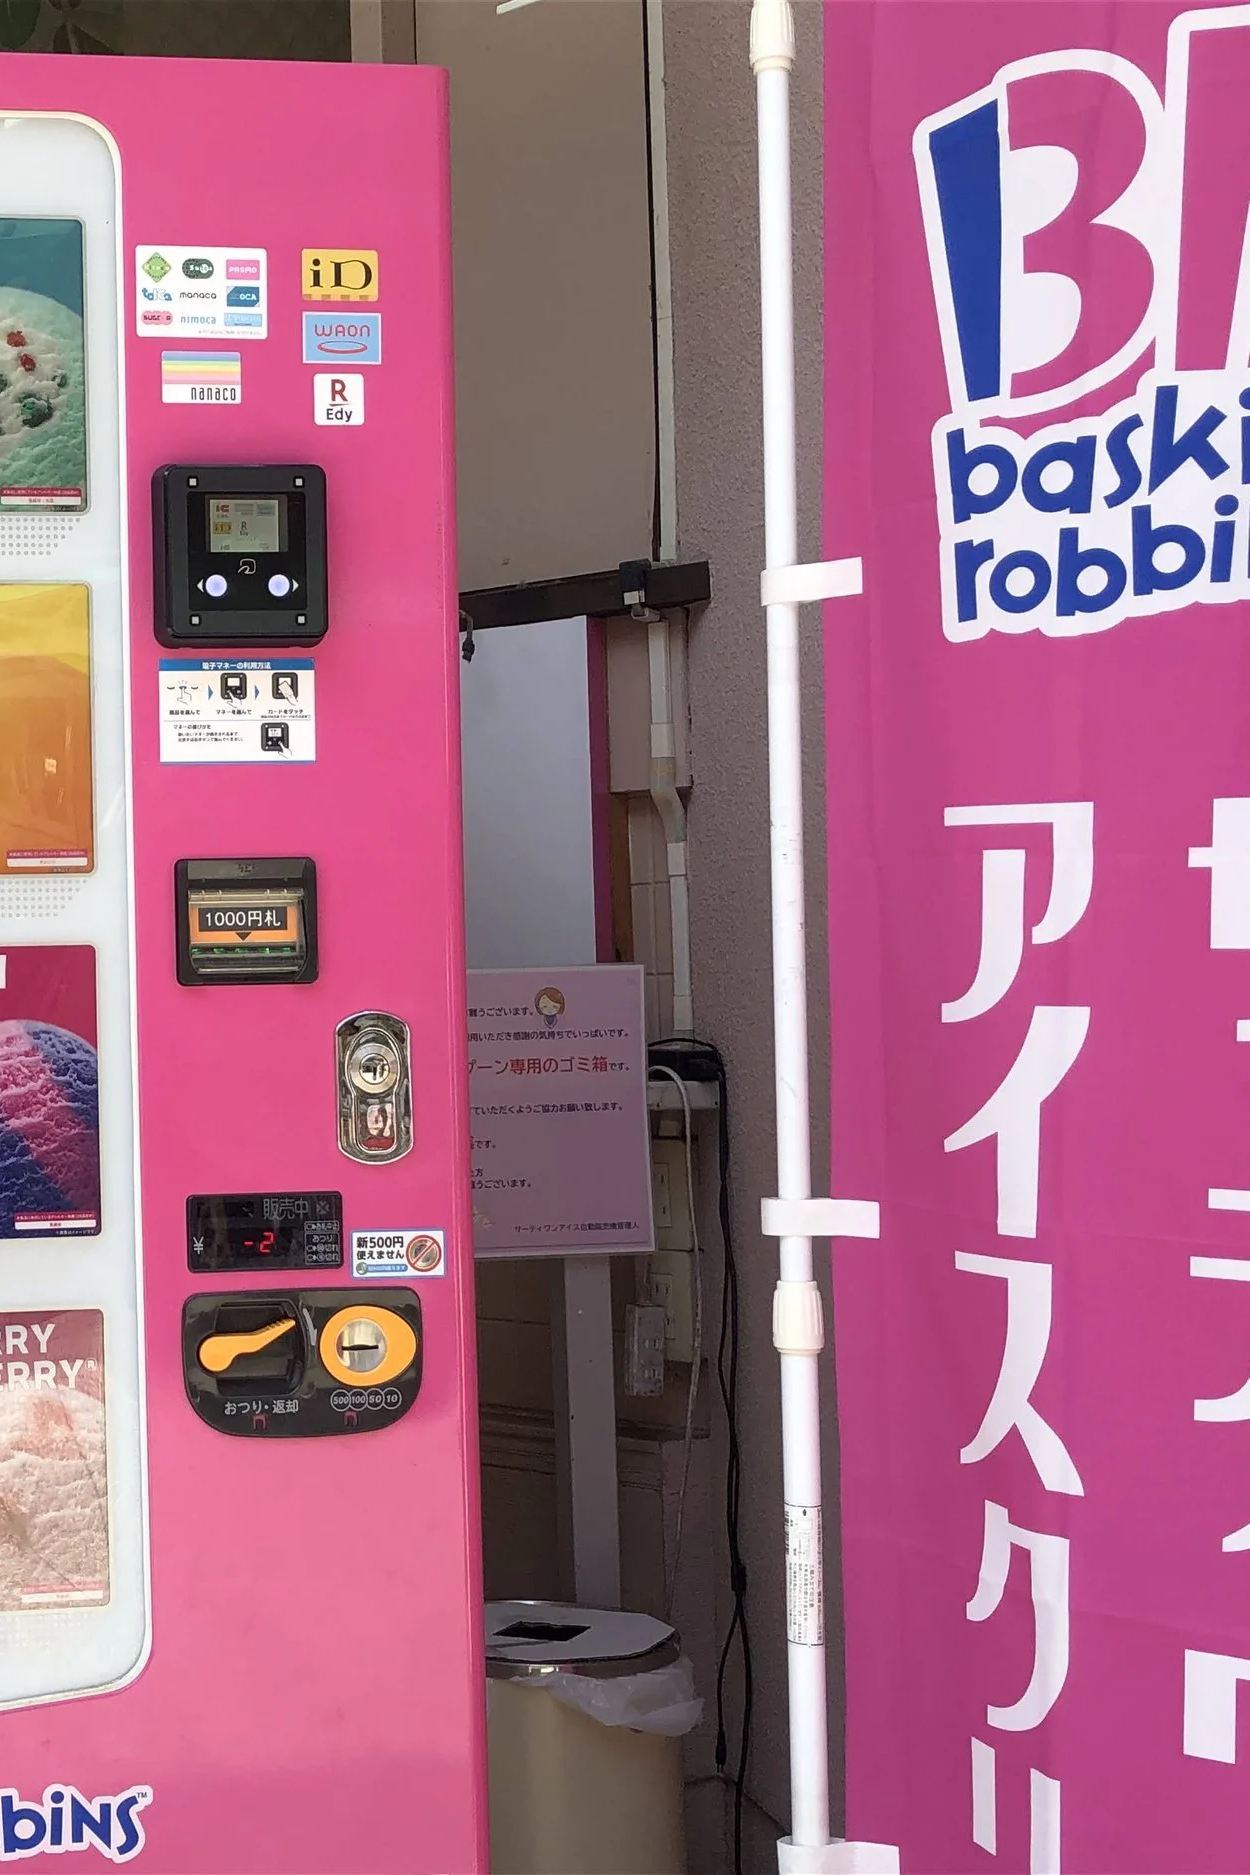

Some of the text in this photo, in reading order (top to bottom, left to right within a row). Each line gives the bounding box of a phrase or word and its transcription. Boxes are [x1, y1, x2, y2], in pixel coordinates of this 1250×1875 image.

[309, 258, 373, 291] iD
[181, 315, 217, 325] nimoca
[315, 323, 371, 338] WAON
[190, 387, 237, 402] nanaco
[330, 378, 349, 402] R
[326, 408, 353, 423] Edy
[954, 494, 1250, 623] robbi
[205, 909, 281, 927] 1000円札
[263, 1197, 309, 1221] 販売中
[356, 1236, 404, 1249] 新500円
[356, 1250, 405, 1260] 使えません
[224, 1400, 299, 1415] おつり・返却
[333, 1394, 398, 1406] 500 100 50 10
